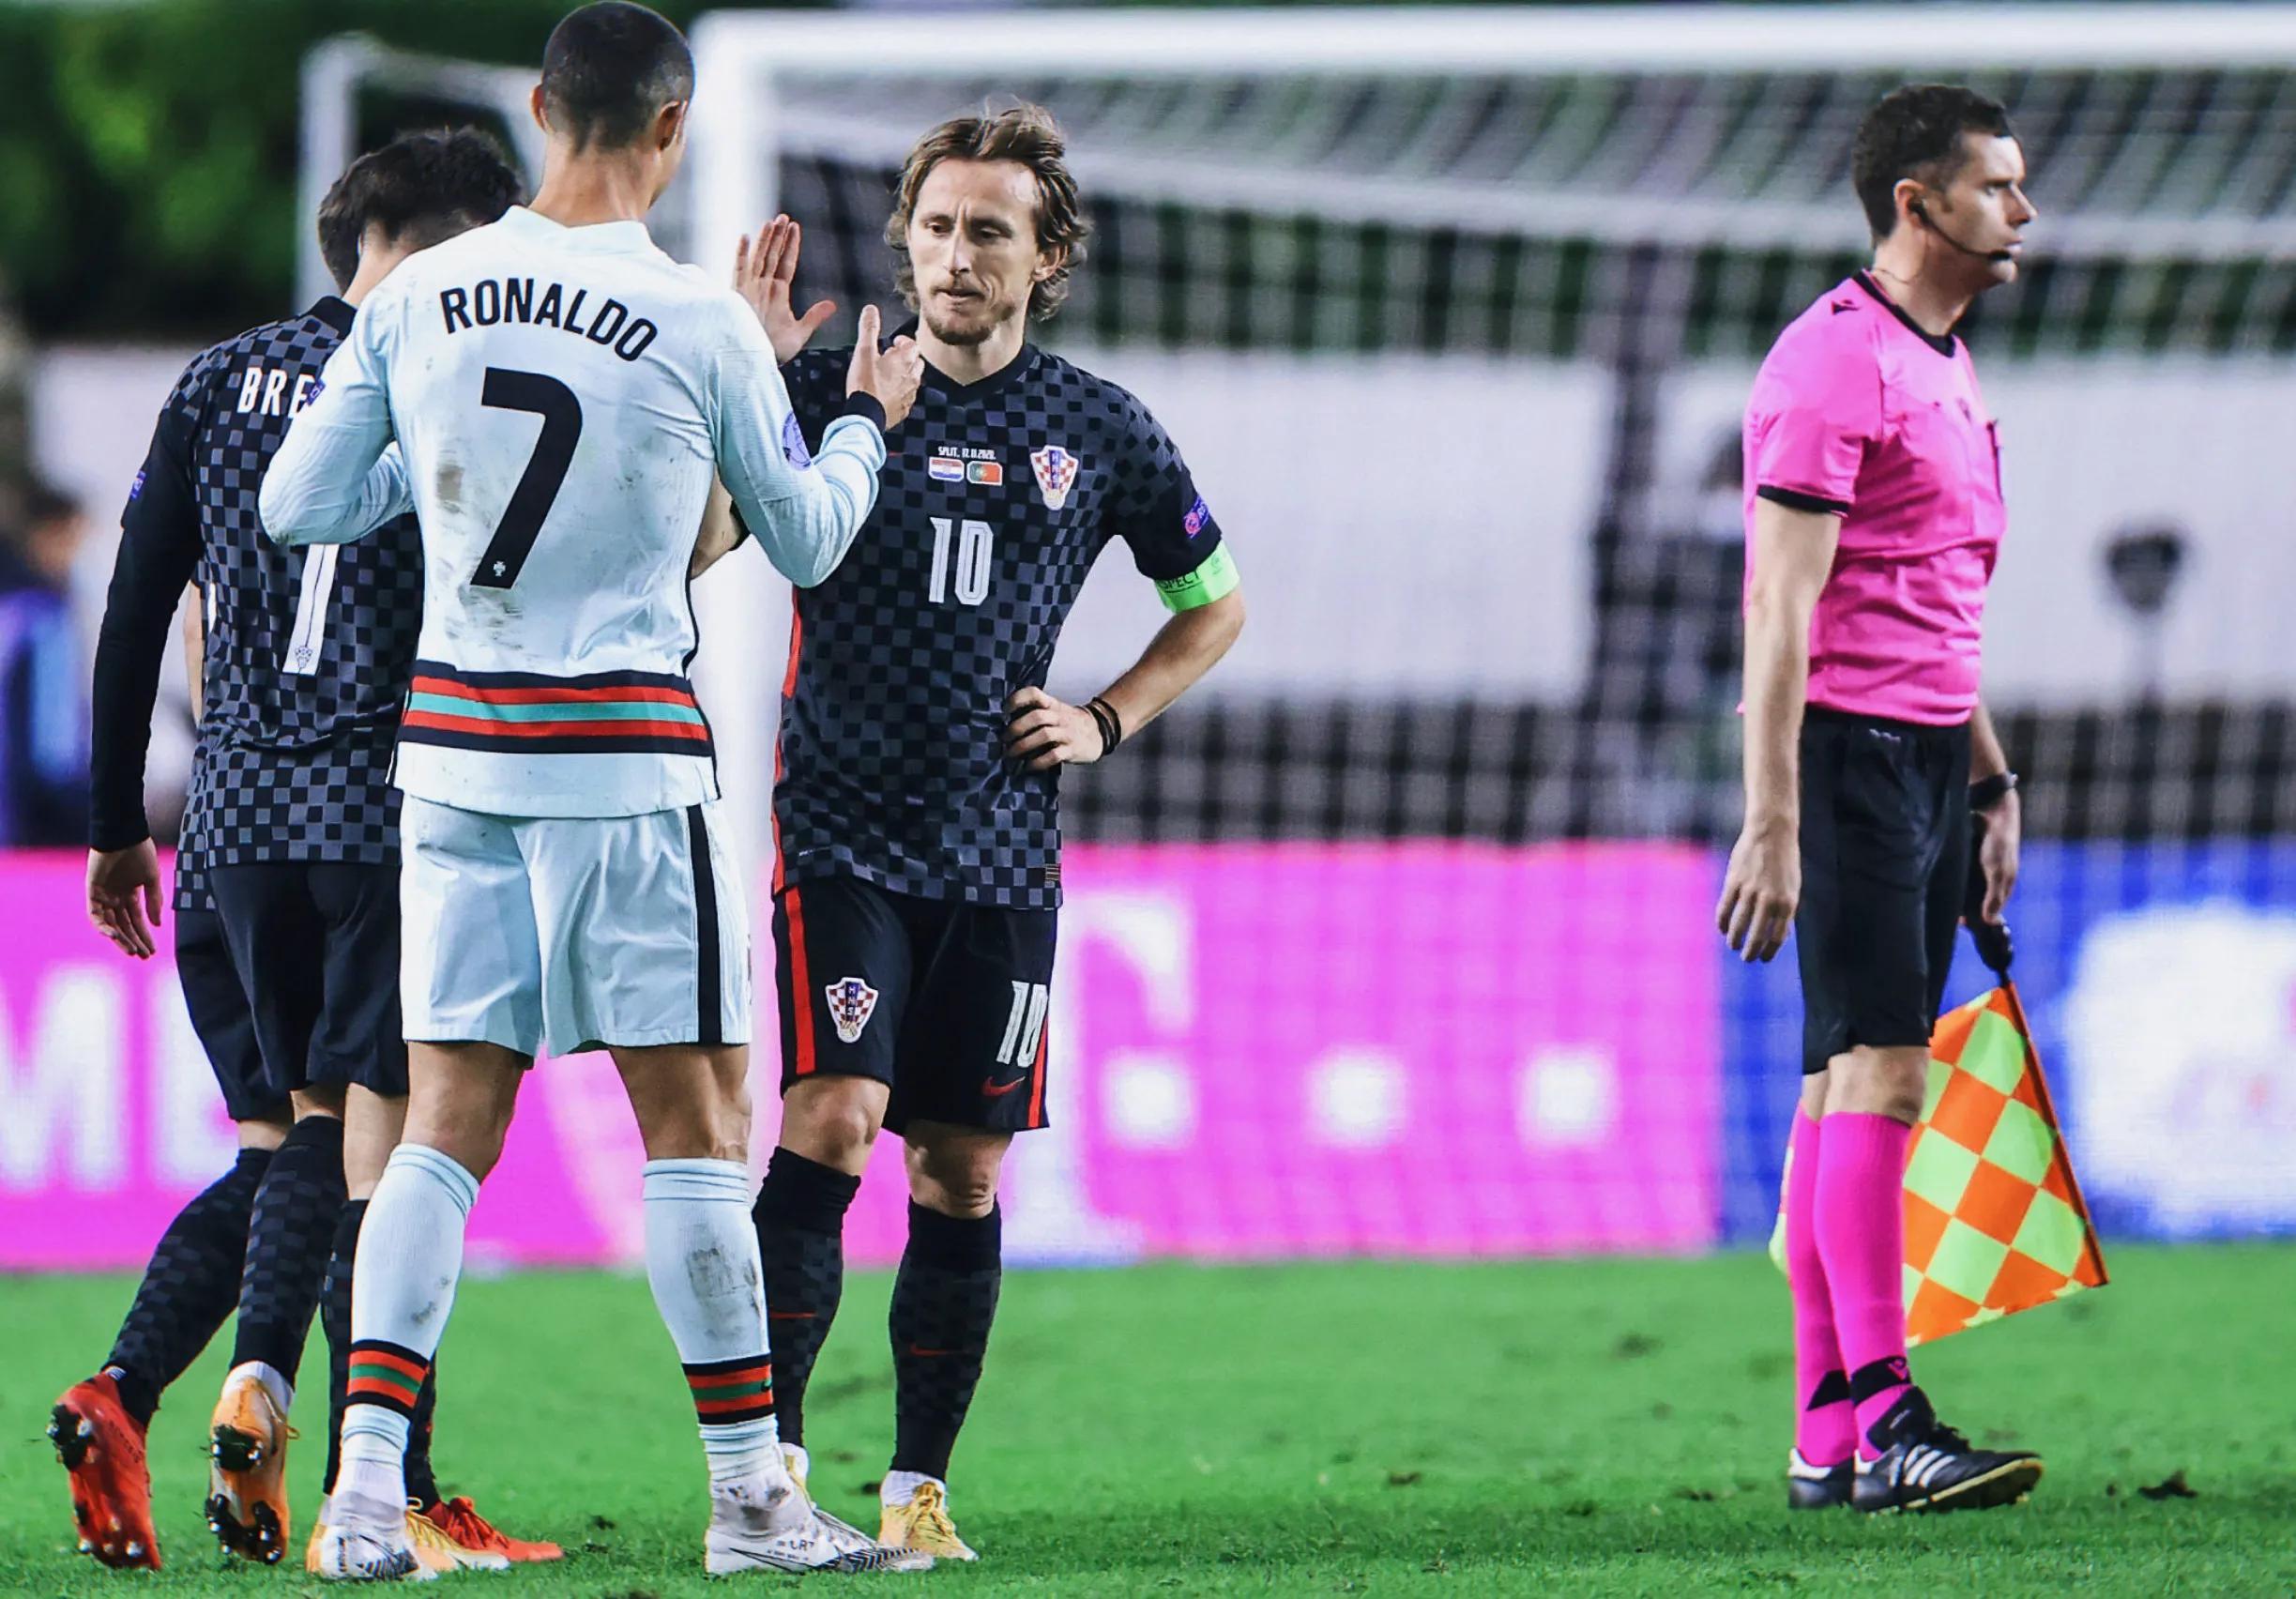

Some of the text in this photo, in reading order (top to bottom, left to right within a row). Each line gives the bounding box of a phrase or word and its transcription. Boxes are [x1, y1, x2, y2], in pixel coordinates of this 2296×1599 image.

[440, 278, 658, 361] RONALDO
[469, 367, 583, 589] 7
[929, 516, 994, 606] 10
[996, 980, 1049, 1068] 10
